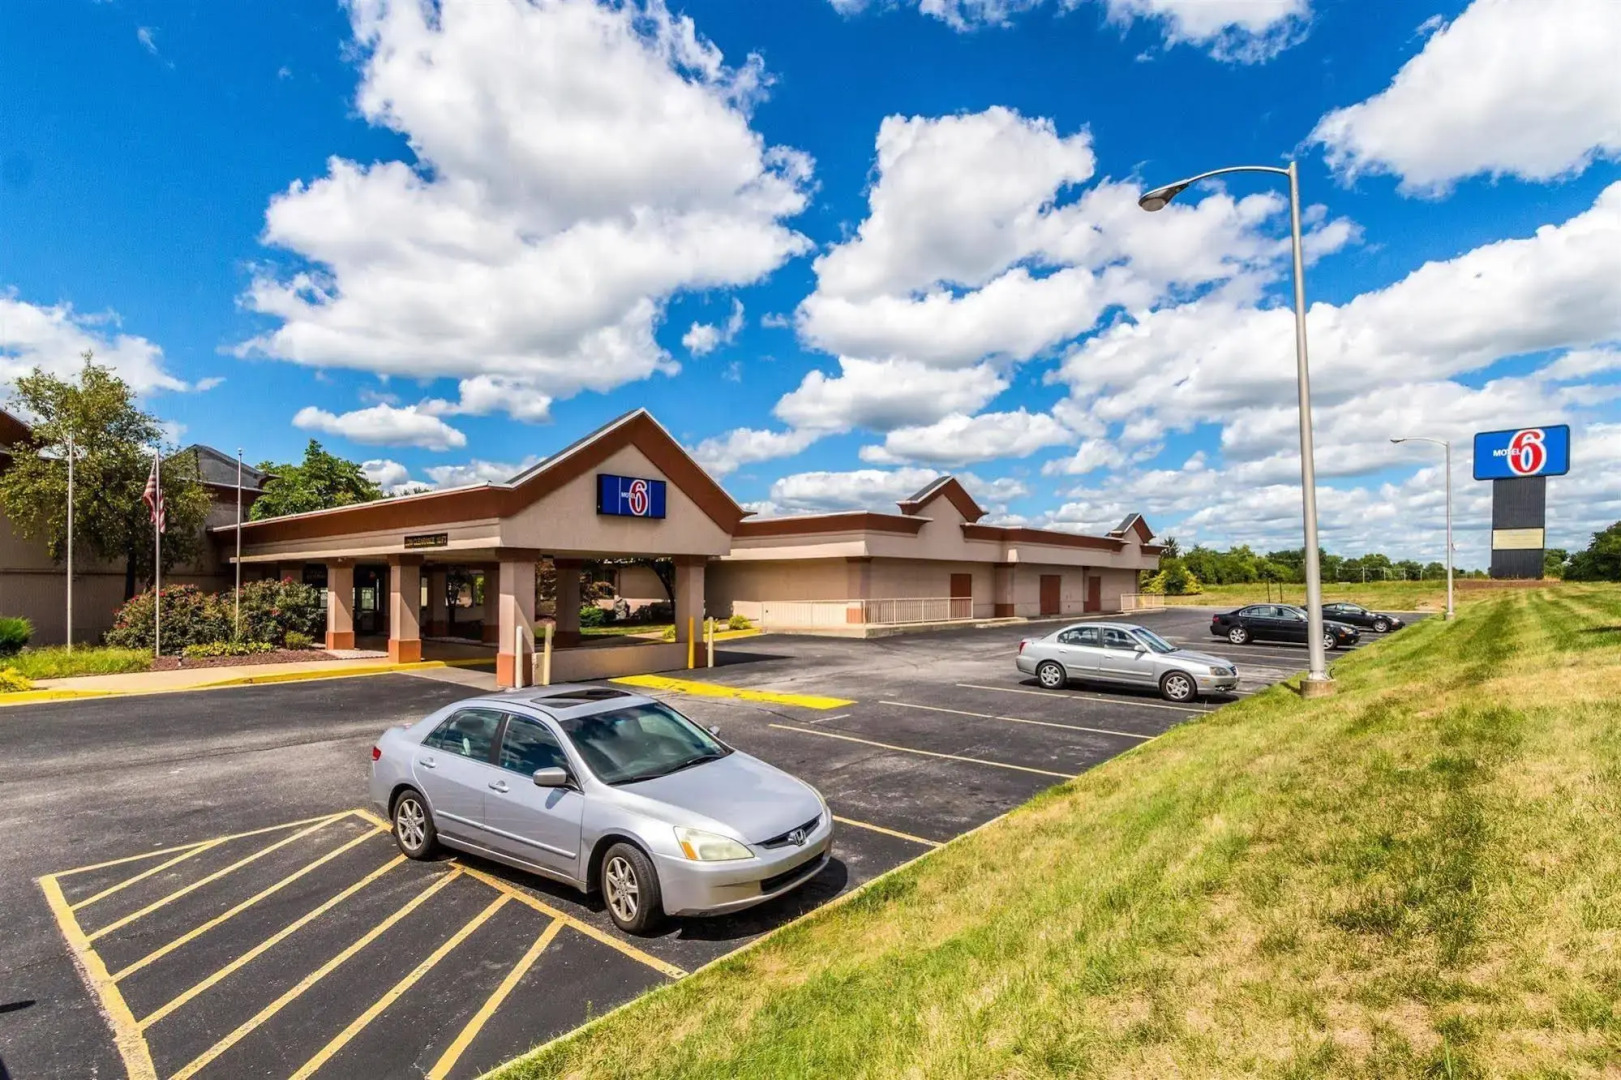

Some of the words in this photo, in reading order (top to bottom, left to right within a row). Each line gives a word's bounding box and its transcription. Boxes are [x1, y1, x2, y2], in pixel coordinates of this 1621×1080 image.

[1493, 448, 1521, 457] MOTEL
[1507, 428, 1547, 475] 6
[629, 479, 648, 516] 6
